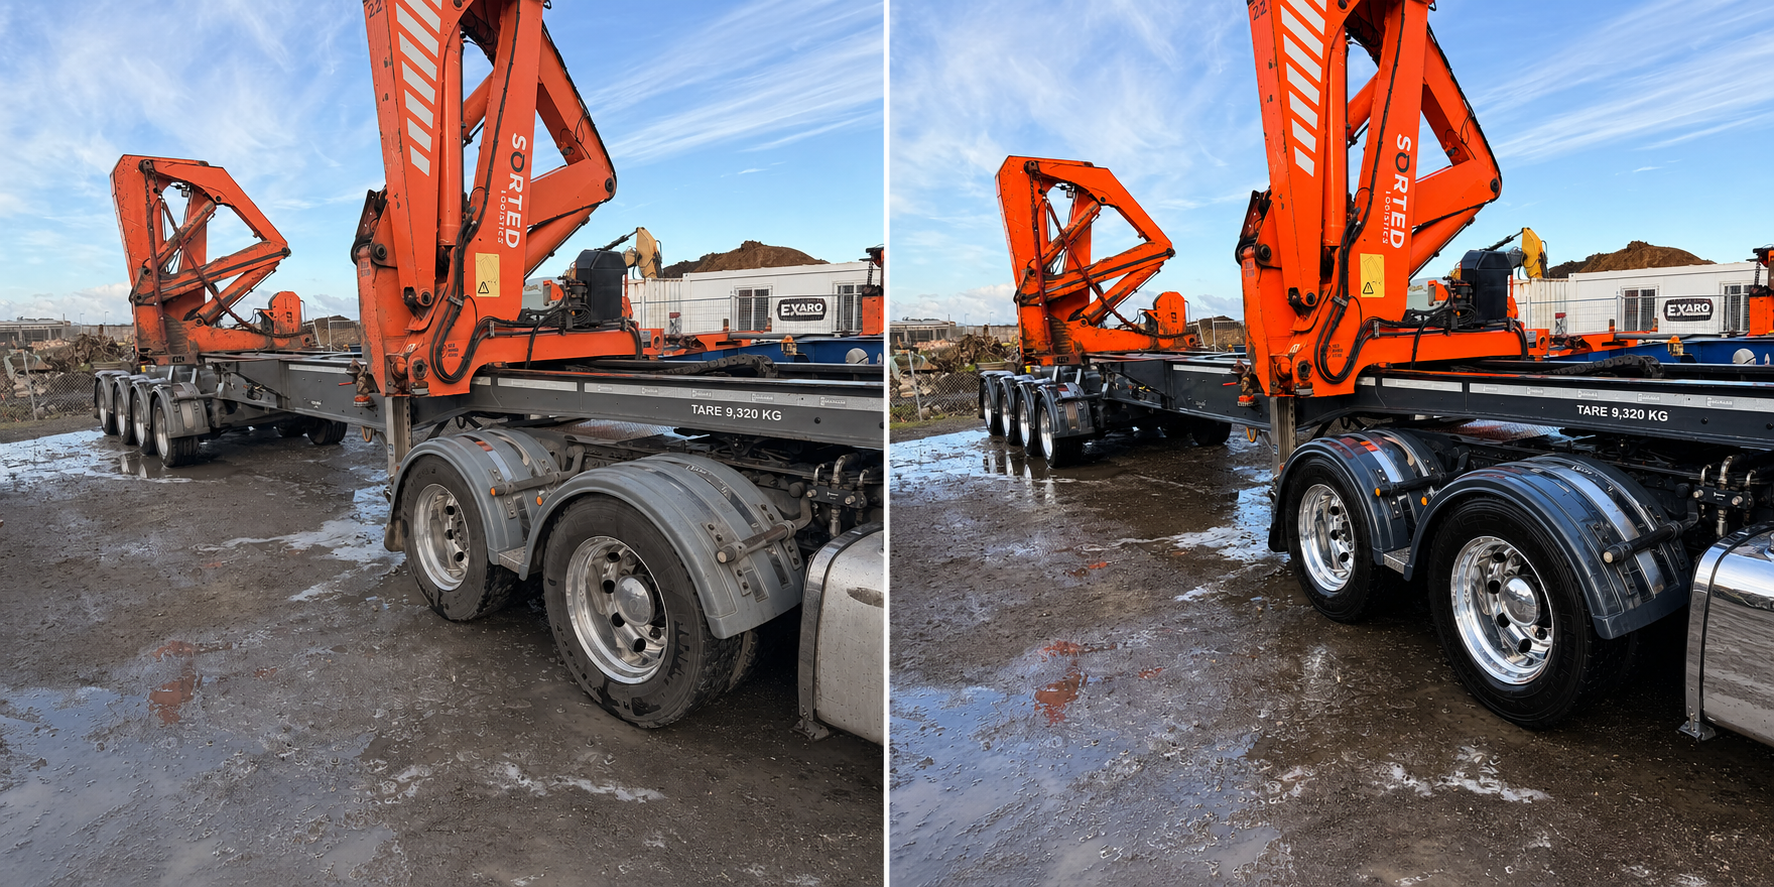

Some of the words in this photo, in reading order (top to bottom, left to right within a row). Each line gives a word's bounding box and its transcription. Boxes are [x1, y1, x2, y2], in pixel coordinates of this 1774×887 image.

[1252, 0, 1268, 21] 22
[505, 132, 527, 248] SORTED
[1390, 133, 1412, 249] SORTED
[781, 302, 823, 316] EXARO
[1667, 303, 1711, 316] EXARO
[691, 404, 722, 416] TARE
[726, 407, 759, 420] 9,320
[762, 409, 782, 421] KG
[1576, 404, 1608, 417] TARE
[1611, 407, 1645, 420] 9,320
[1648, 410, 1669, 422] KG
